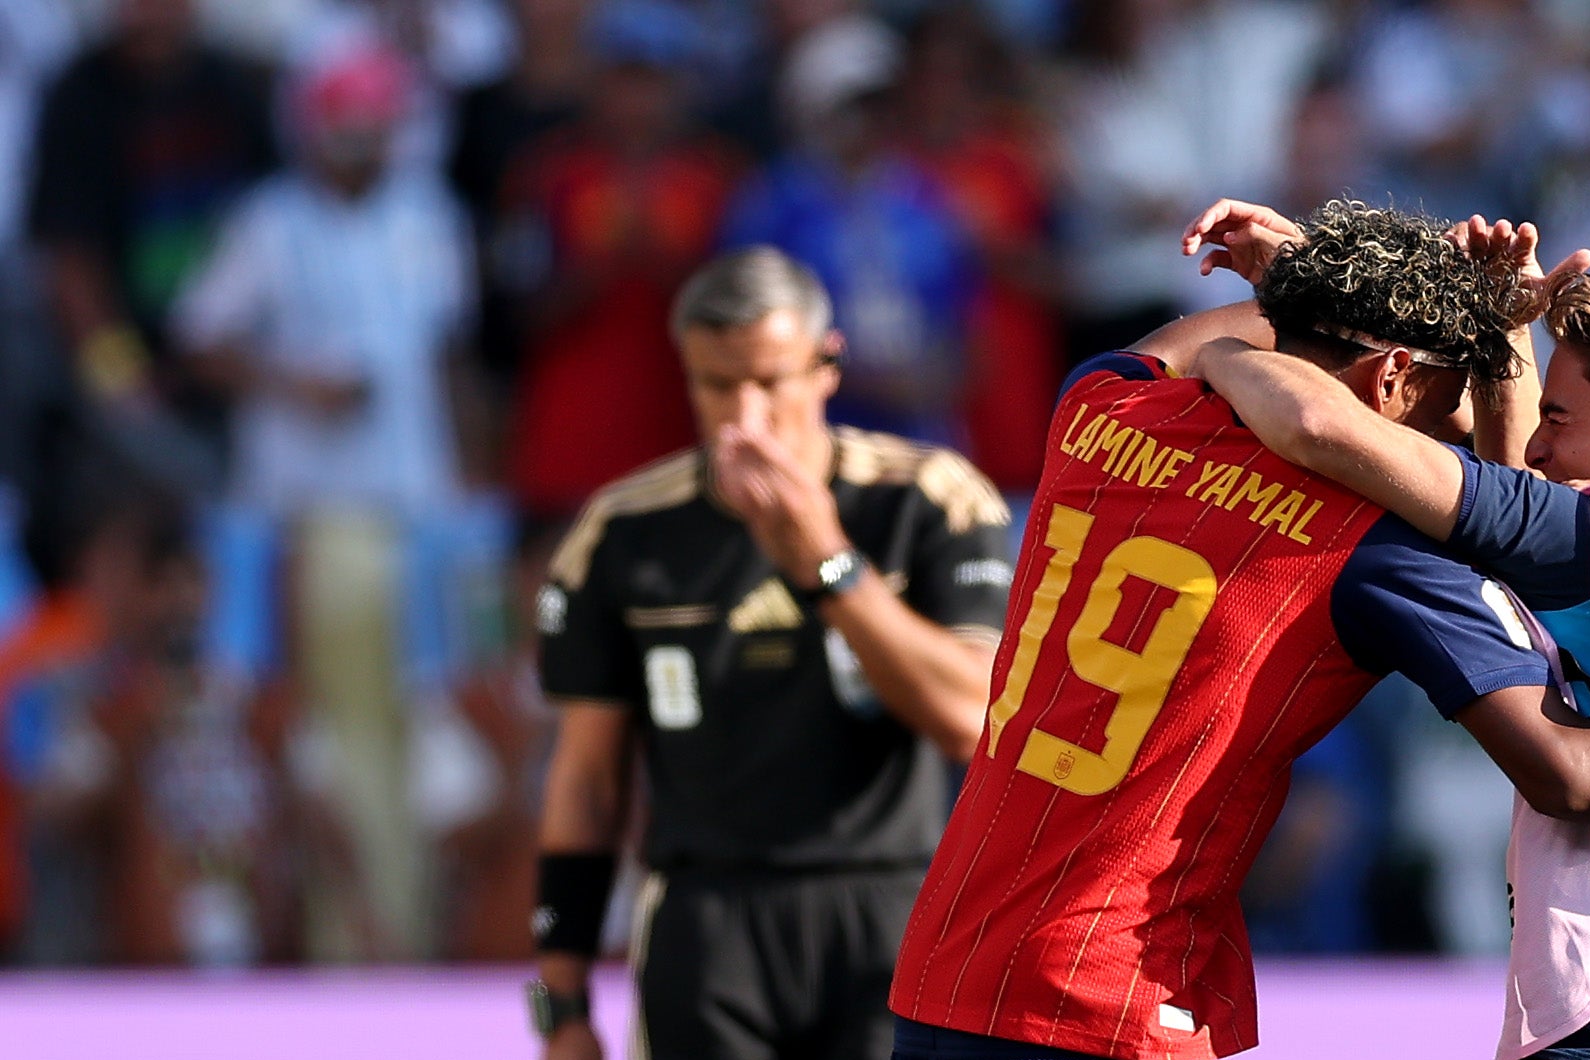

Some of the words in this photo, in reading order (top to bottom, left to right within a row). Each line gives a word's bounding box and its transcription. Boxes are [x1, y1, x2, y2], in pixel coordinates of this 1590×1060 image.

[1060, 403, 1195, 489] LAMINE
[1185, 460, 1324, 546] YAMAL
[987, 503, 1217, 797] 19
